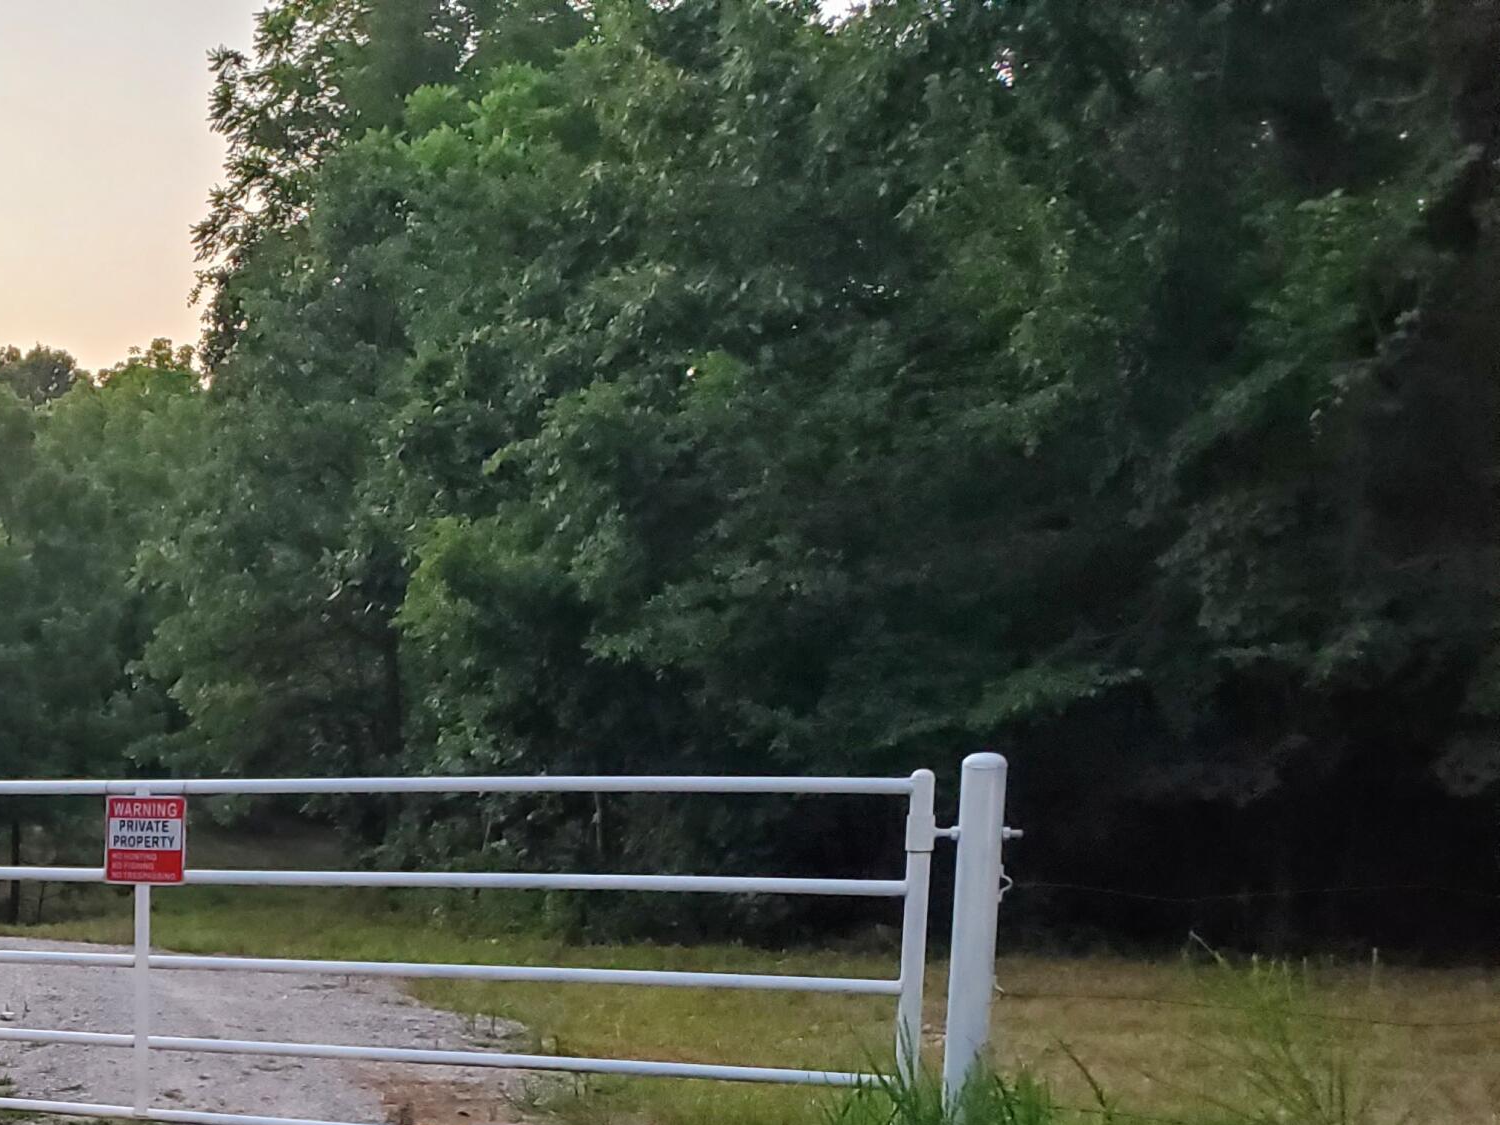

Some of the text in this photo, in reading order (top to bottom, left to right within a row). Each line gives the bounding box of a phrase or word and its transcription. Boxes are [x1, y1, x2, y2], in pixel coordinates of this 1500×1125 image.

[113, 802, 178, 817] WARNING
[119, 820, 169, 832] PRIVATE
[113, 835, 175, 848] PROPERTY
